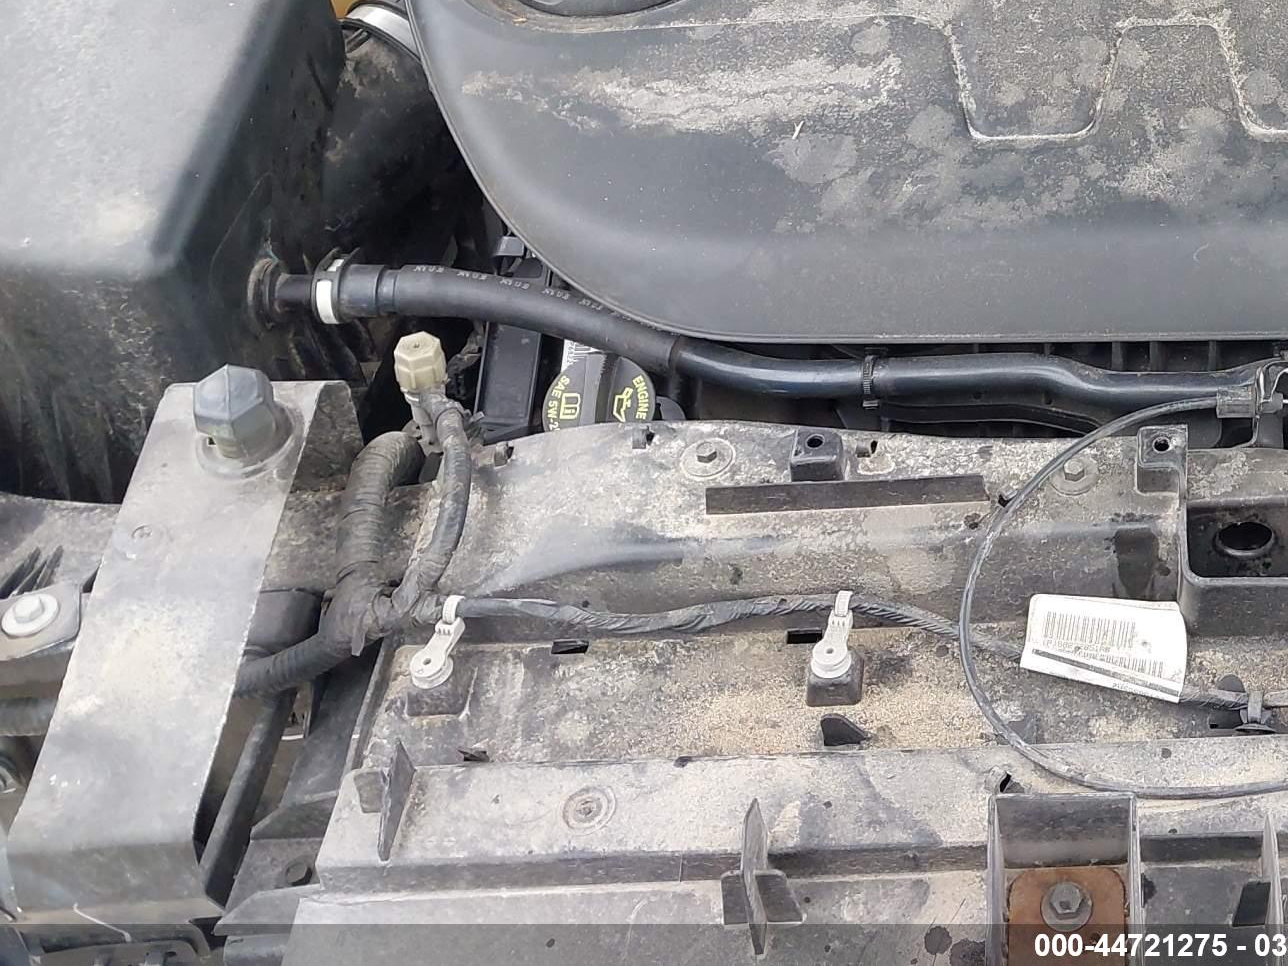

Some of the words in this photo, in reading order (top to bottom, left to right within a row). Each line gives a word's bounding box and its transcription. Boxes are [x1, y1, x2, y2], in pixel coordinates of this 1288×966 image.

[551, 375, 570, 399] SAE
[632, 375, 649, 420] ENGINE
[547, 400, 560, 432] 5W-2
